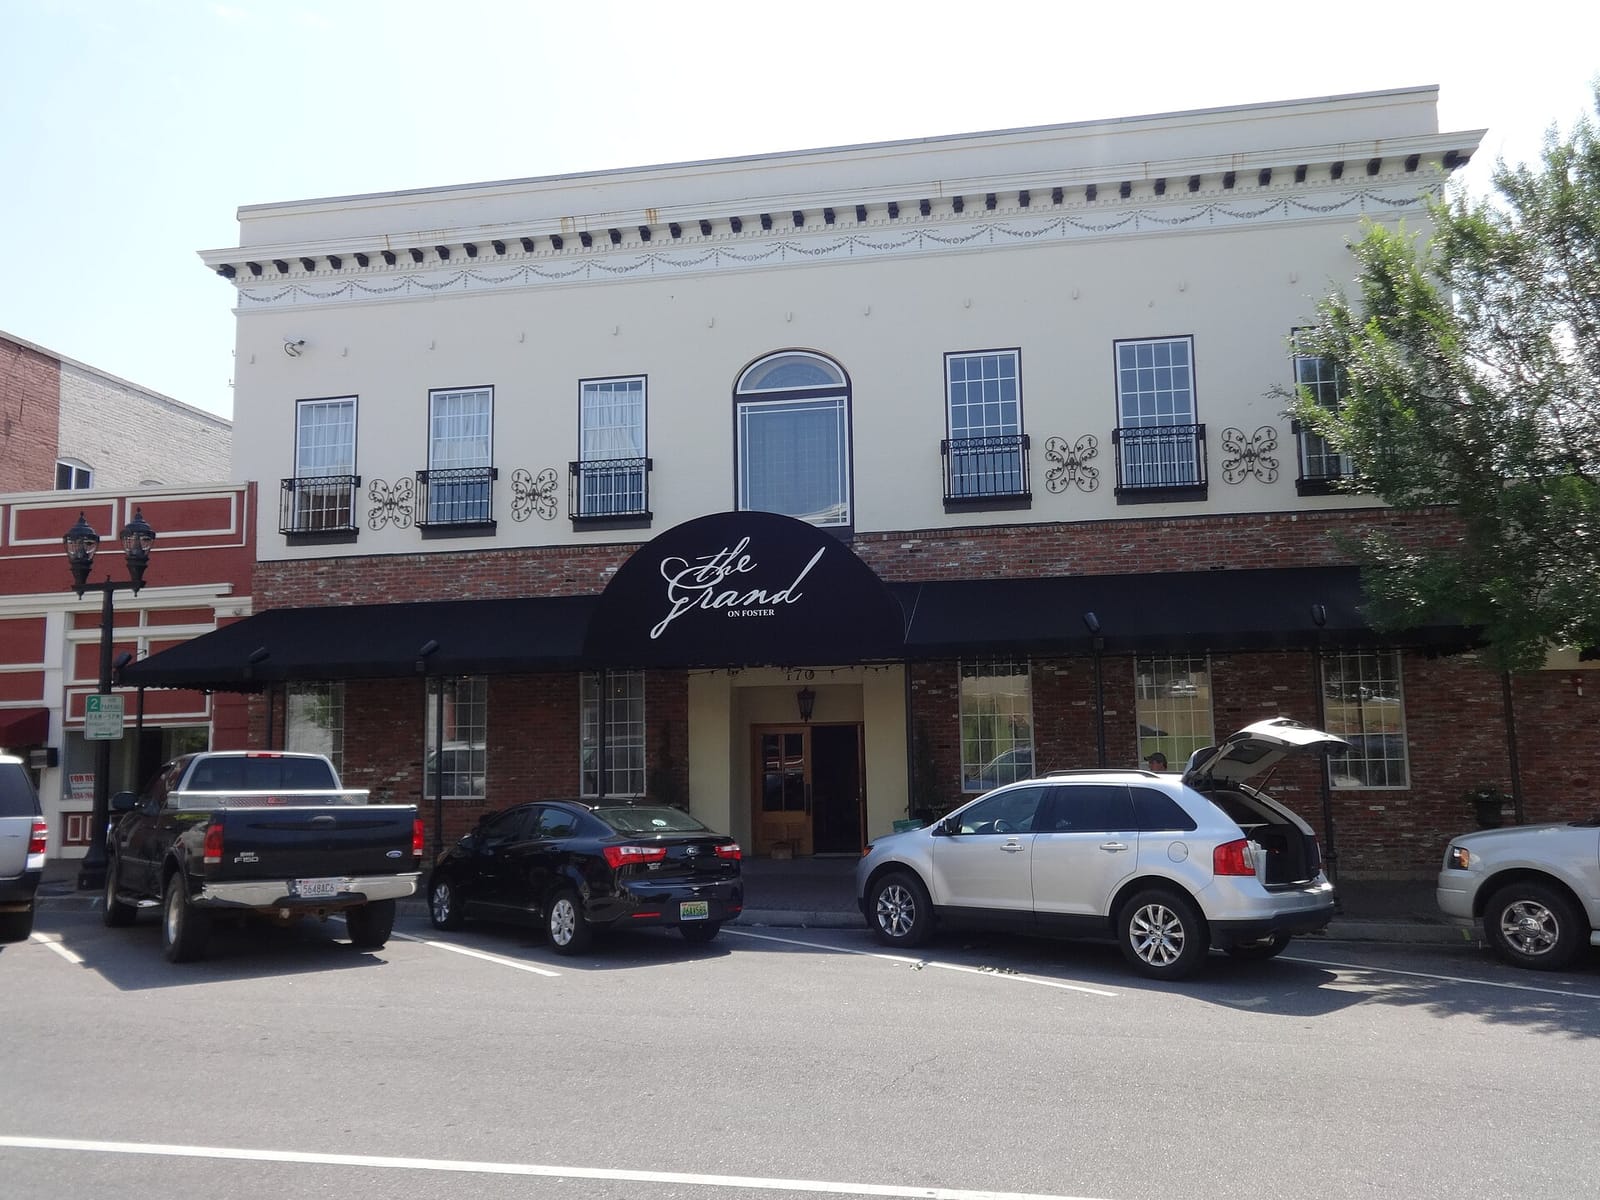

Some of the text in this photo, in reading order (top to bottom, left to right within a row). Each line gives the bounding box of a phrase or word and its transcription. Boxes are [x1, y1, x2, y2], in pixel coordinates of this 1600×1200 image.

[693, 536, 757, 582] the
[650, 546, 826, 639] Grand
[727, 609, 775, 618] ON FOSTER
[90, 698, 99, 710] 2
[70, 774, 84, 783] FOR
